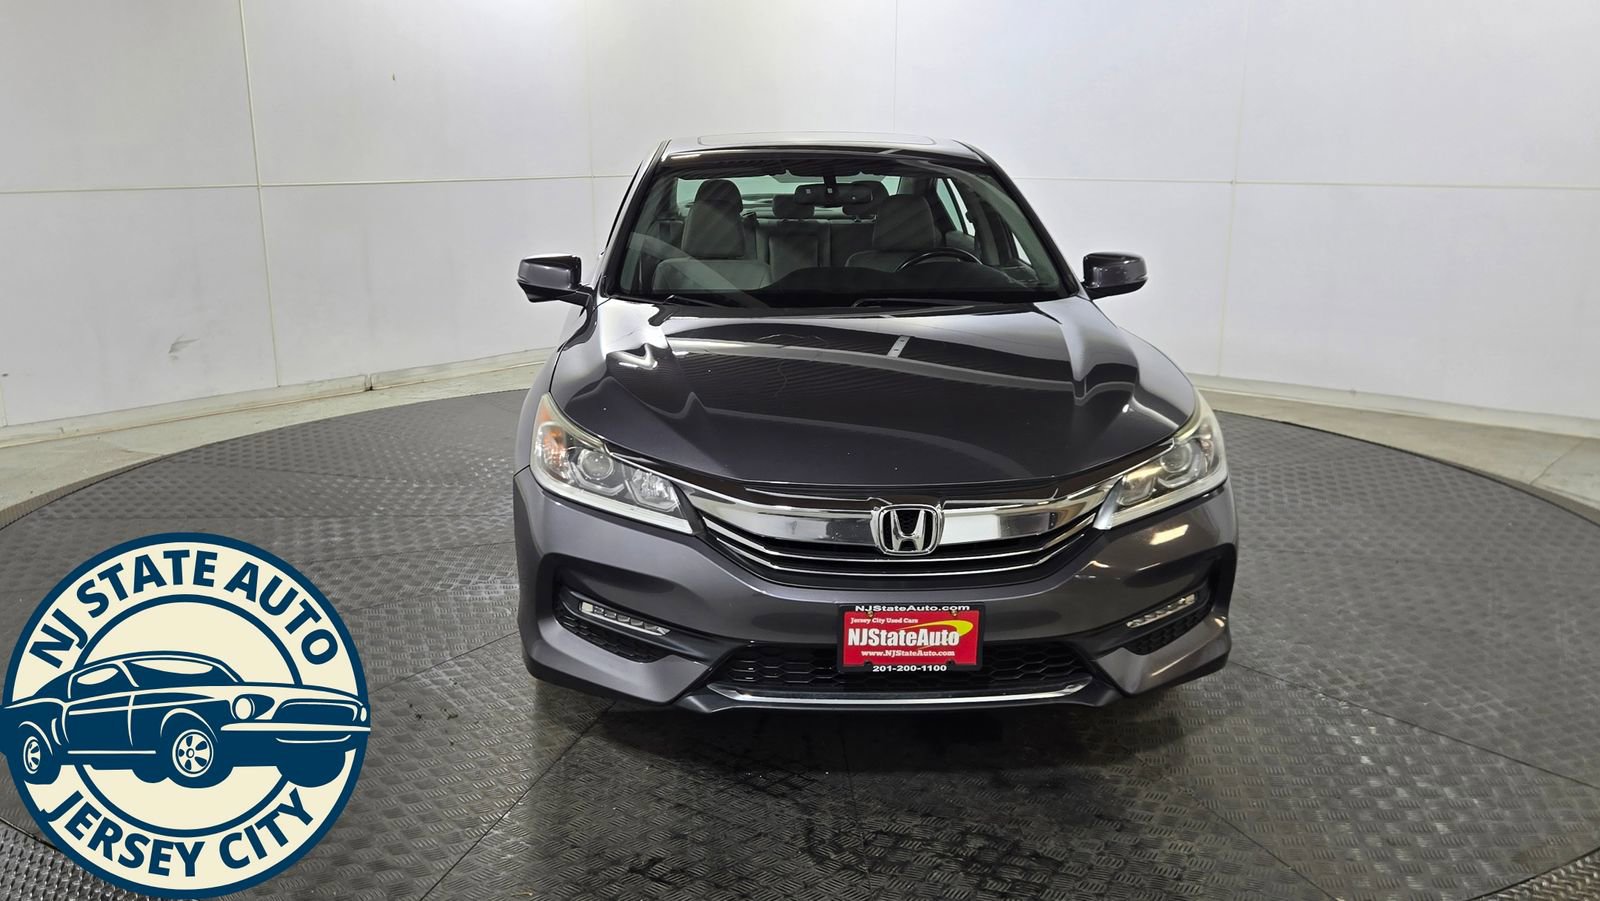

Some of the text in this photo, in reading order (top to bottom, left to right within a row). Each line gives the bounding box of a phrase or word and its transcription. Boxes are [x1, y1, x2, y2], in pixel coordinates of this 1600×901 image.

[855, 604, 970, 612] NJStateAuto.com
[850, 617, 871, 625] Jersey
[872, 617, 885, 625] City
[848, 628, 960, 646] NJStateAuto
[861, 649, 955, 657] www.NJStateAuto.com
